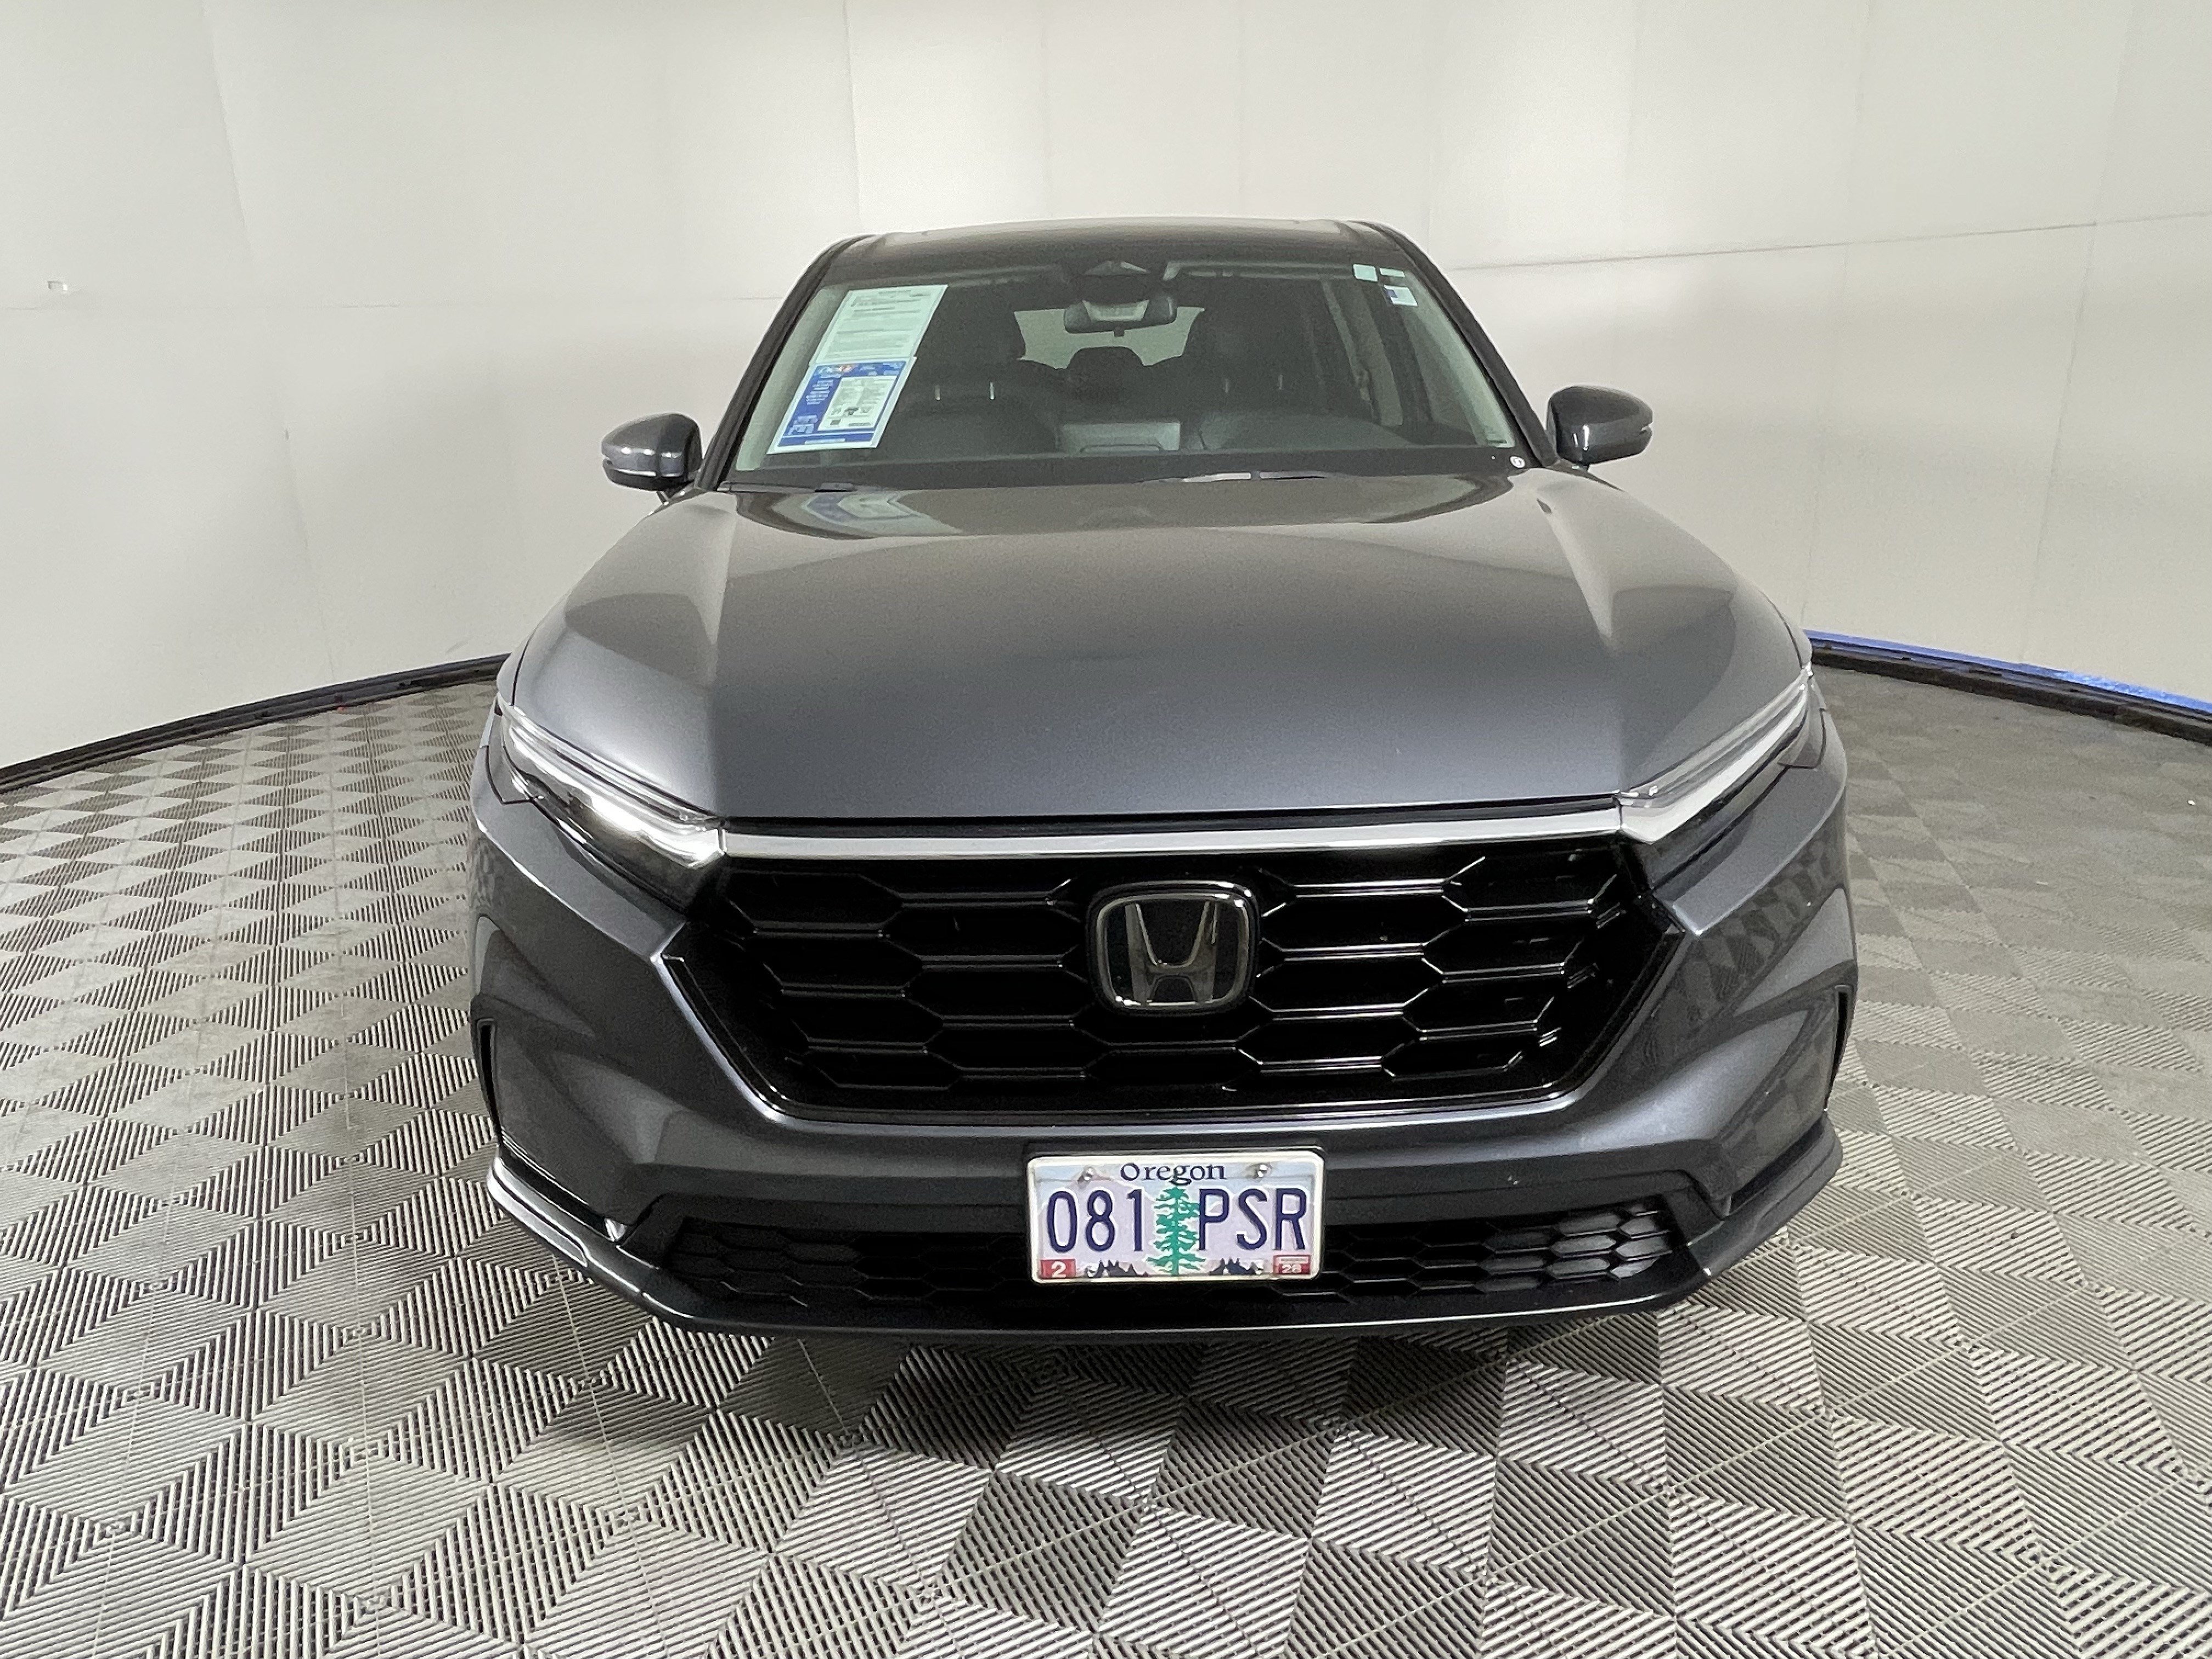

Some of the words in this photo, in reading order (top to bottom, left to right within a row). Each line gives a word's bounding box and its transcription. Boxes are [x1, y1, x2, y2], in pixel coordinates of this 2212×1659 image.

[1120, 1163, 1227, 1186] Oregon
[1047, 1188, 1143, 1252] 081
[1198, 1188, 1307, 1251] PSR
[1051, 1261, 1066, 1278] 2
